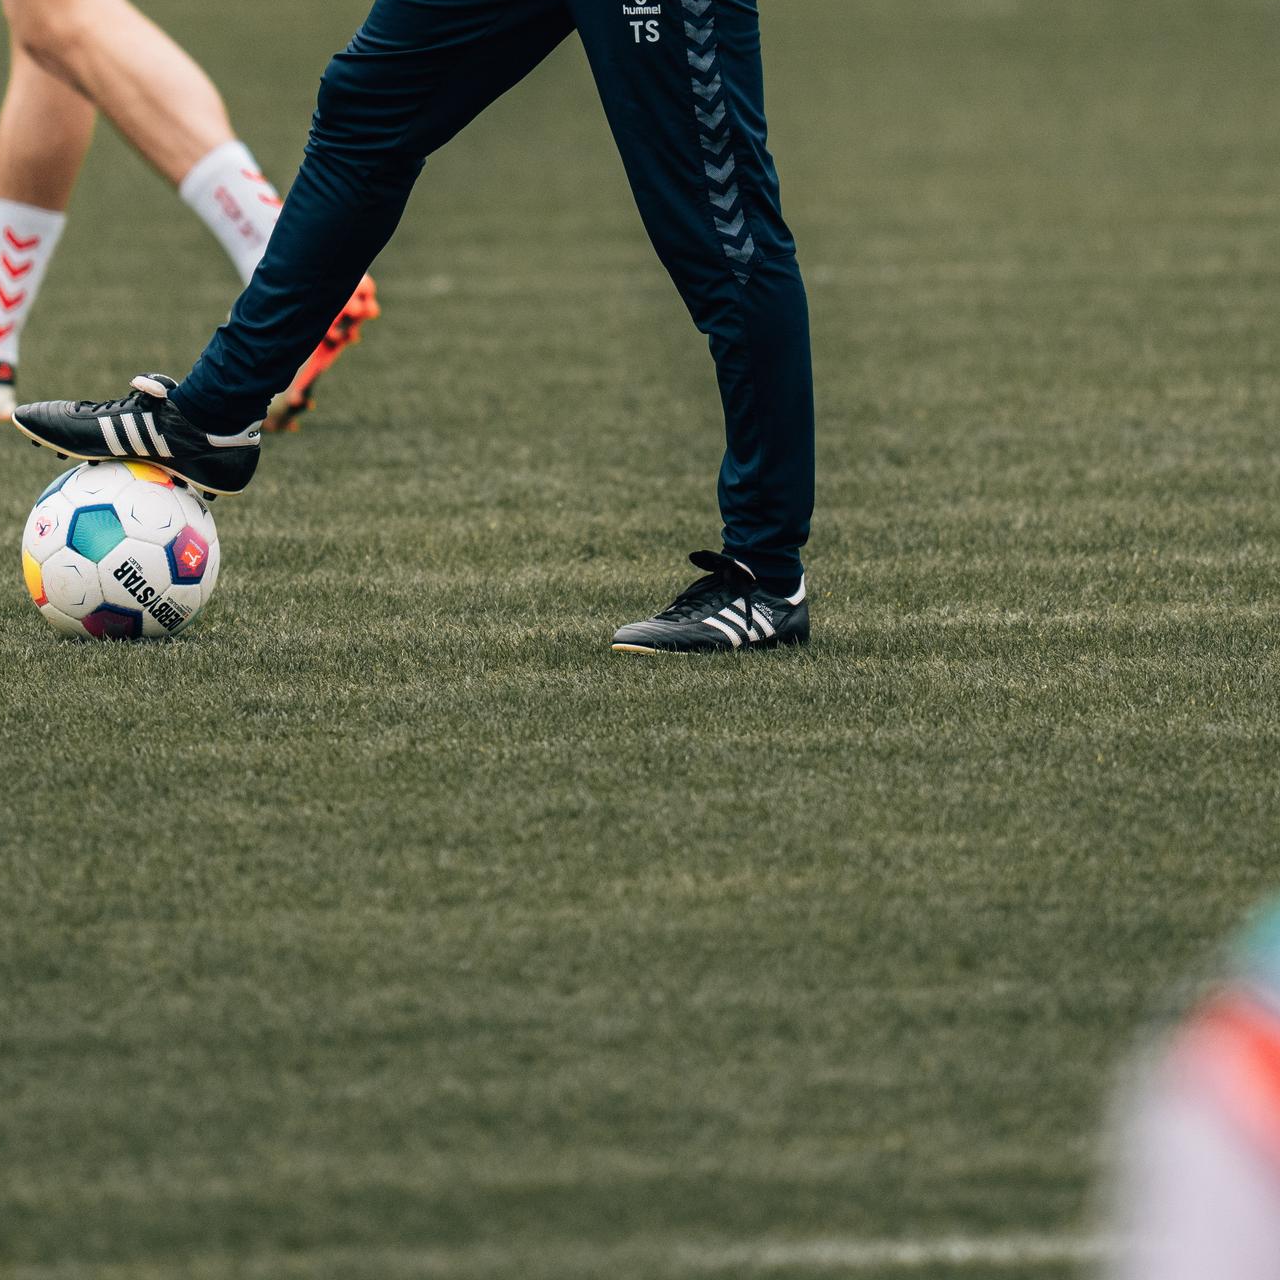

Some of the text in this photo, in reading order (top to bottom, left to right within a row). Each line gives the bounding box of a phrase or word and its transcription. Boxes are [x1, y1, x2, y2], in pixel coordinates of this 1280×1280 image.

[622, 4, 661, 15] hummel
[629, 19, 660, 43] TS
[113, 560, 185, 631] DERBYSTAR
